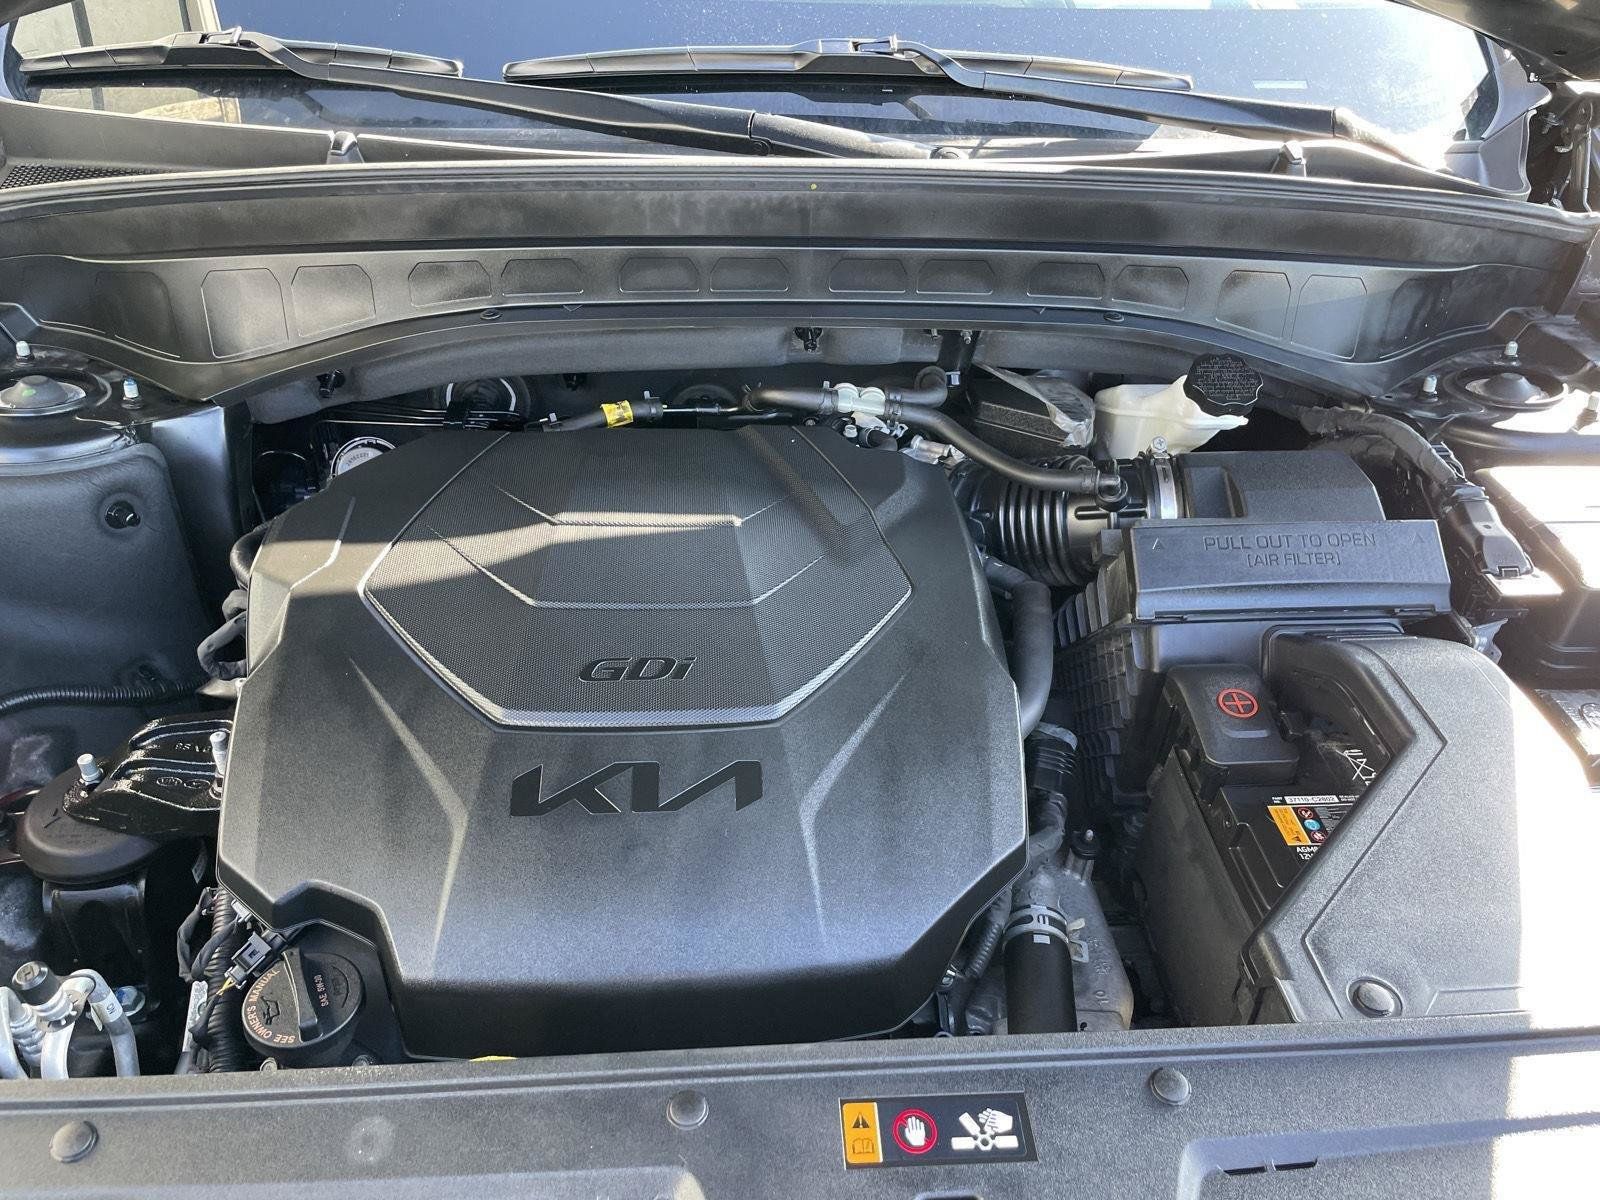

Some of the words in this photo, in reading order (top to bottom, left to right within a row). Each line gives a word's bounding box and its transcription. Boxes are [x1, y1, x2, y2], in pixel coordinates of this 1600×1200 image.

[1203, 535, 1251, 551] PULL
[1255, 534, 1292, 550] OUT
[1299, 533, 1323, 549] TO
[1327, 532, 1376, 547] OPEN
[578, 656, 697, 682] GDi
[510, 759, 763, 817] KIA
[248, 969, 280, 1002] MANUAL
[319, 993, 328, 1006] SAE
[273, 1034, 296, 1044] SEE
